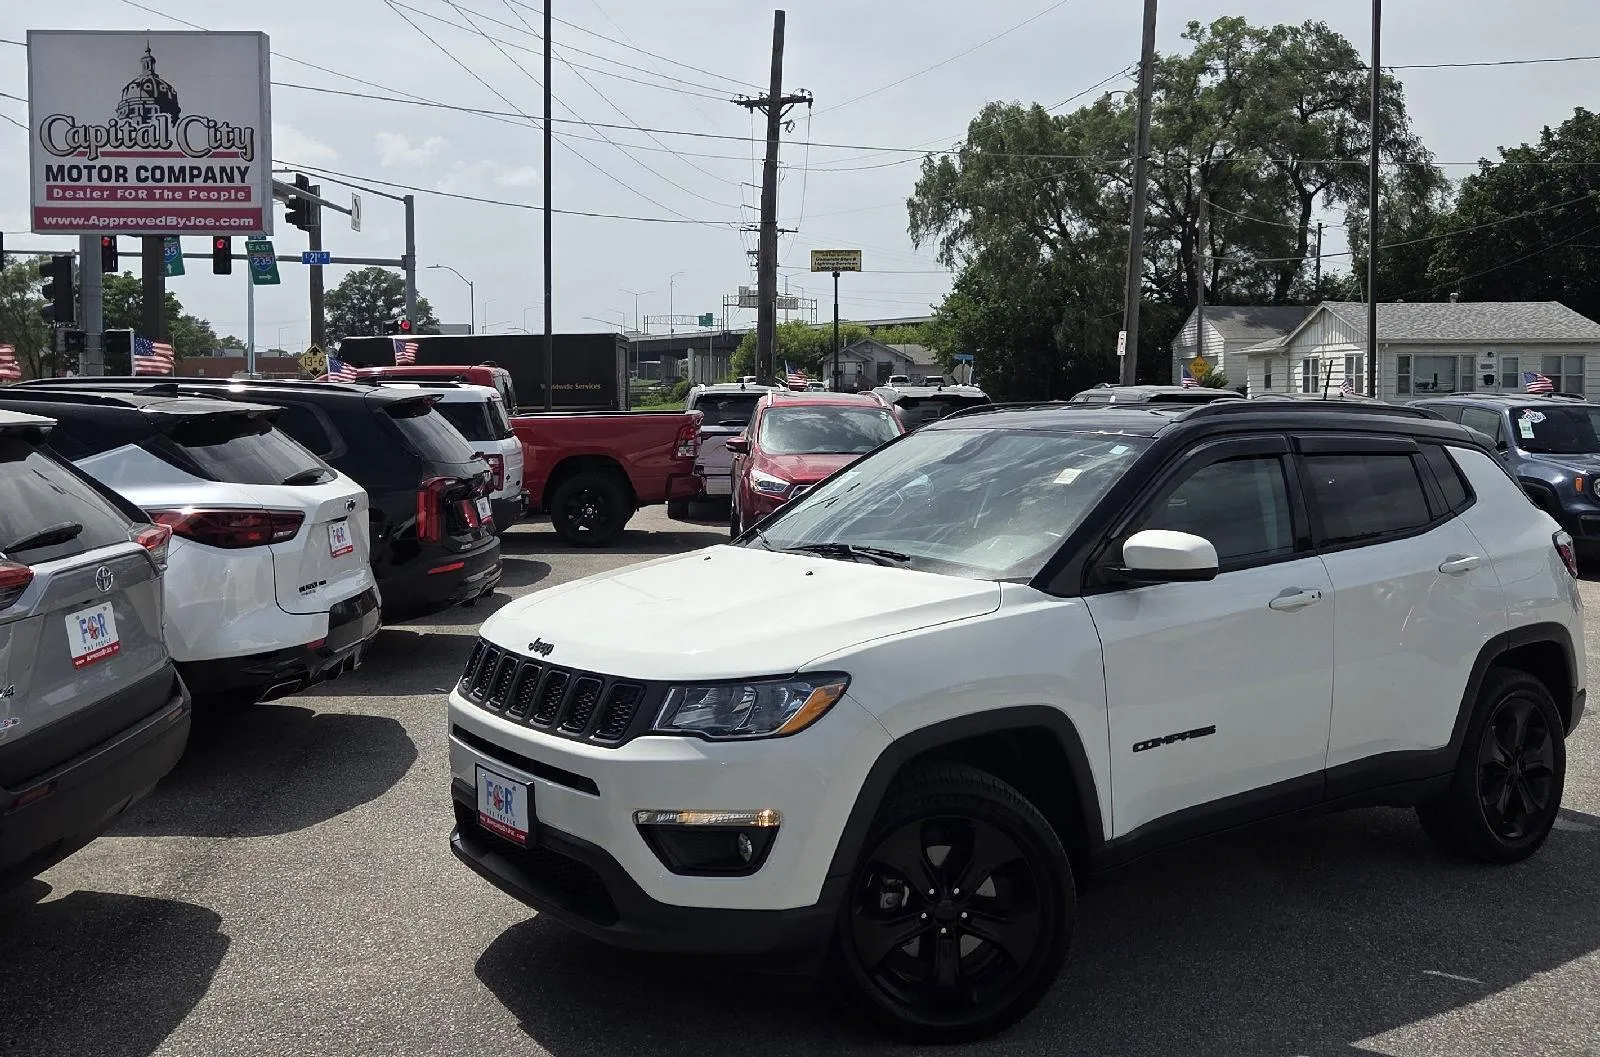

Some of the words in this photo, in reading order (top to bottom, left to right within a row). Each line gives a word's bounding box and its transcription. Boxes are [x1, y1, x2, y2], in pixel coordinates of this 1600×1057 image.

[40, 113, 173, 161] Capital
[176, 114, 255, 162] City
[45, 165, 129, 183] MOTOR
[135, 165, 250, 184] COMPANY
[53, 188, 110, 199] Dealer
[117, 189, 148, 200] FOR
[153, 189, 183, 200] The
[188, 189, 246, 201] People
[43, 215, 254, 227] www.ApprovedByJoe.com
[164, 246, 177, 256] 35
[248, 243, 270, 251] EAST
[253, 257, 272, 265] 235
[575, 383, 601, 391] Services
[528, 637, 555, 658] Jeep
[1132, 724, 1217, 753] COMPASS
